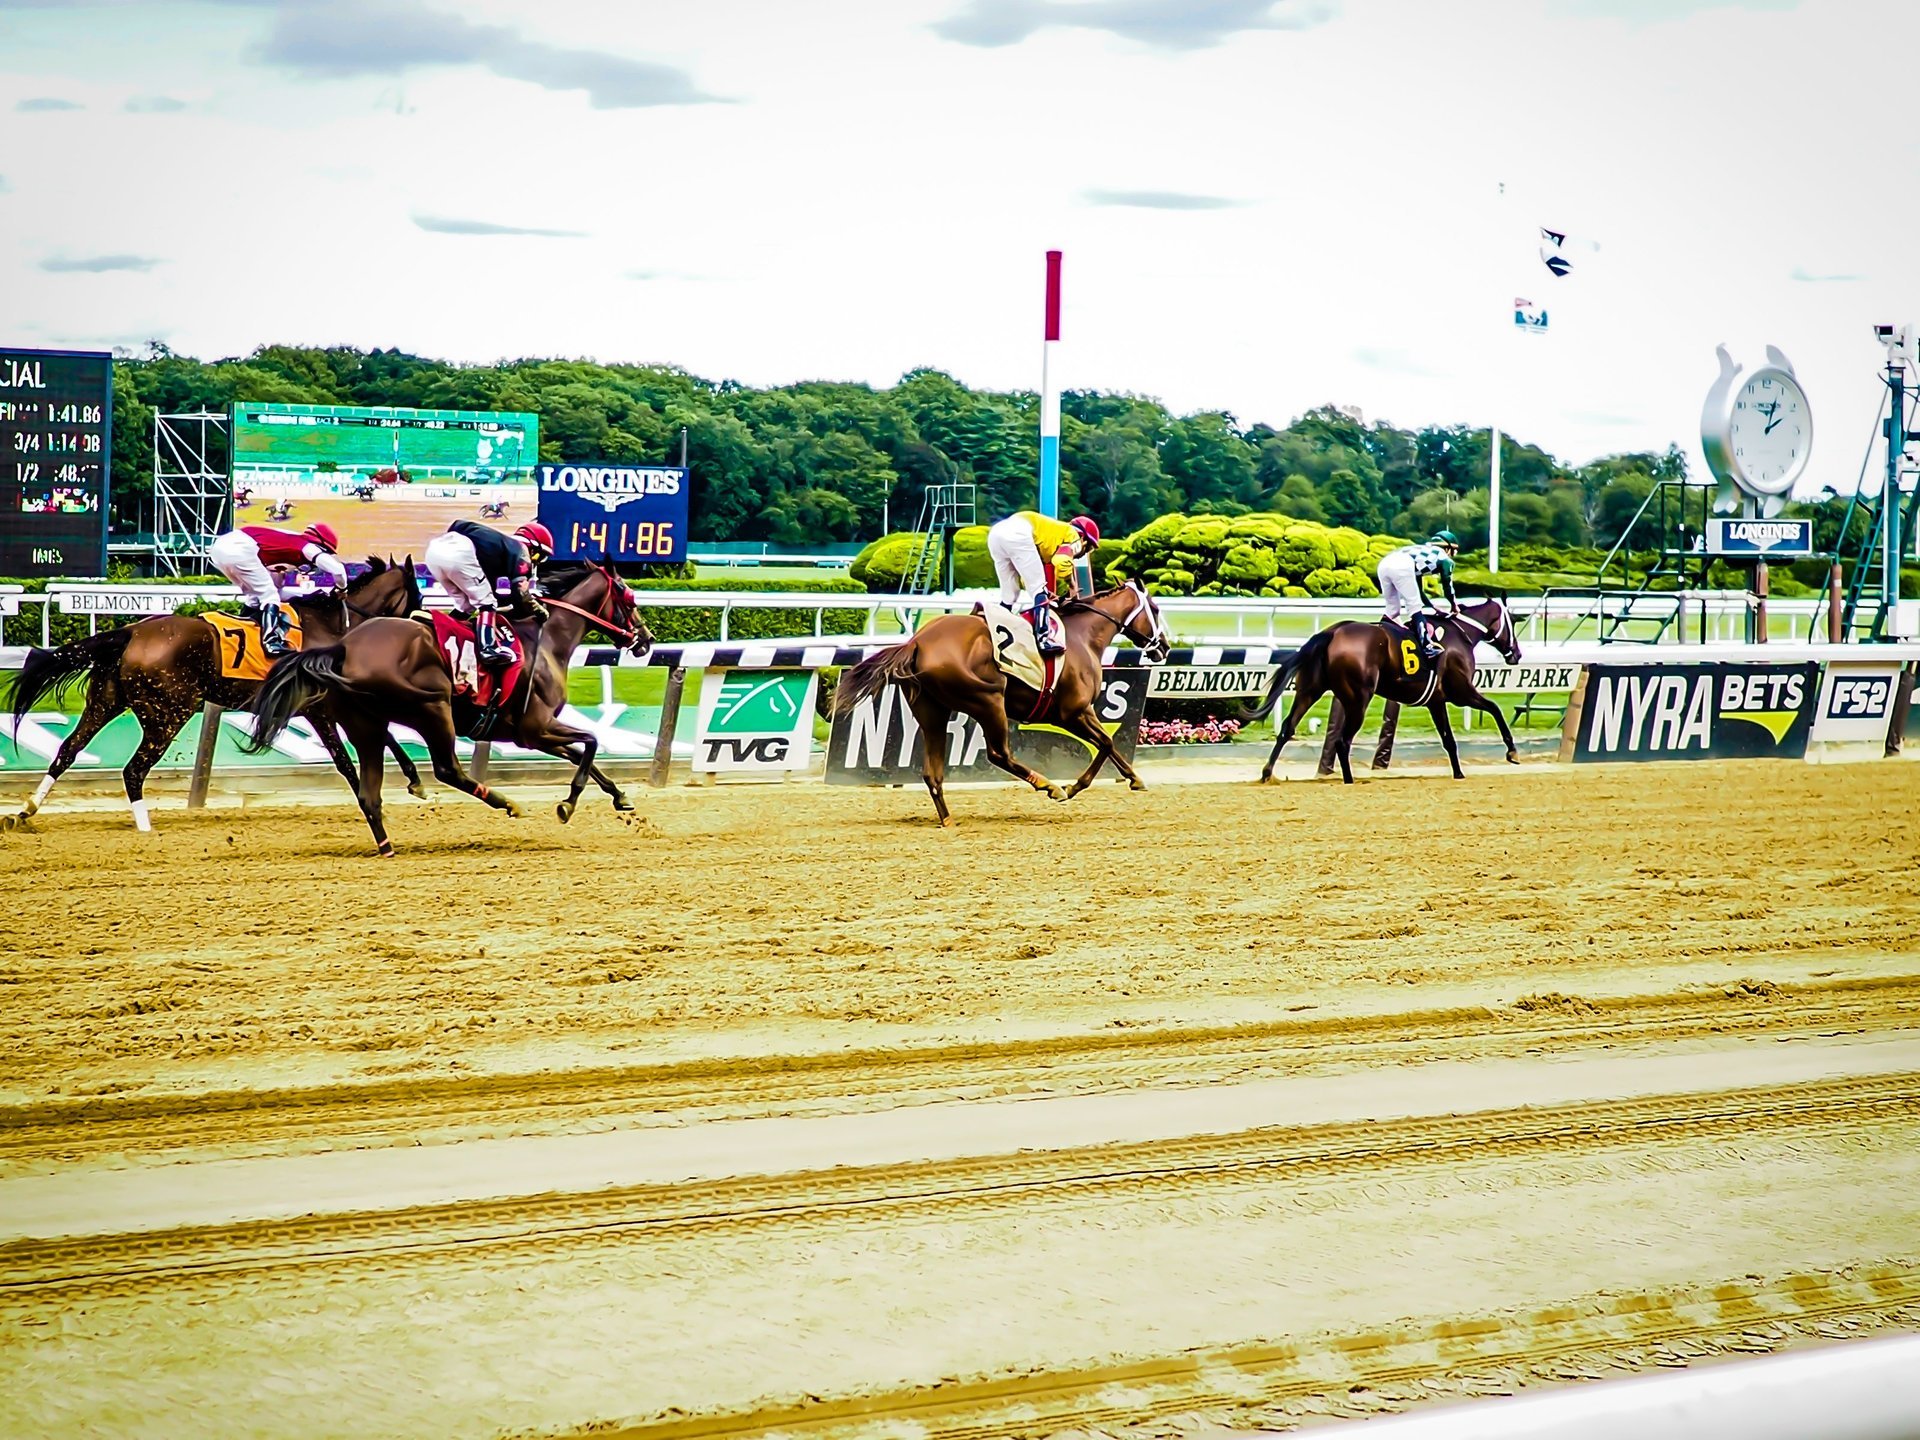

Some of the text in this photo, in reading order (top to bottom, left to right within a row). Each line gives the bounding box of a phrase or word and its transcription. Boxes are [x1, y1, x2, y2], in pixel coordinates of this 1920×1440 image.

[14, 432, 40, 453] 3/4
[541, 466, 683, 495] LONGINES
[571, 522, 674, 555] 1:41.86
[1729, 523, 1801, 540] LONGINES
[71, 594, 153, 610] BELMONT
[223, 628, 246, 669] 7
[996, 624, 1014, 668] 2
[1401, 639, 1420, 675] 6
[1154, 671, 1267, 692] BELMONT
[1516, 668, 1573, 688] PARK
[1588, 673, 1805, 752] NYRA BETS
[1831, 681, 1888, 715] FS2
[702, 737, 790, 763] TVG
